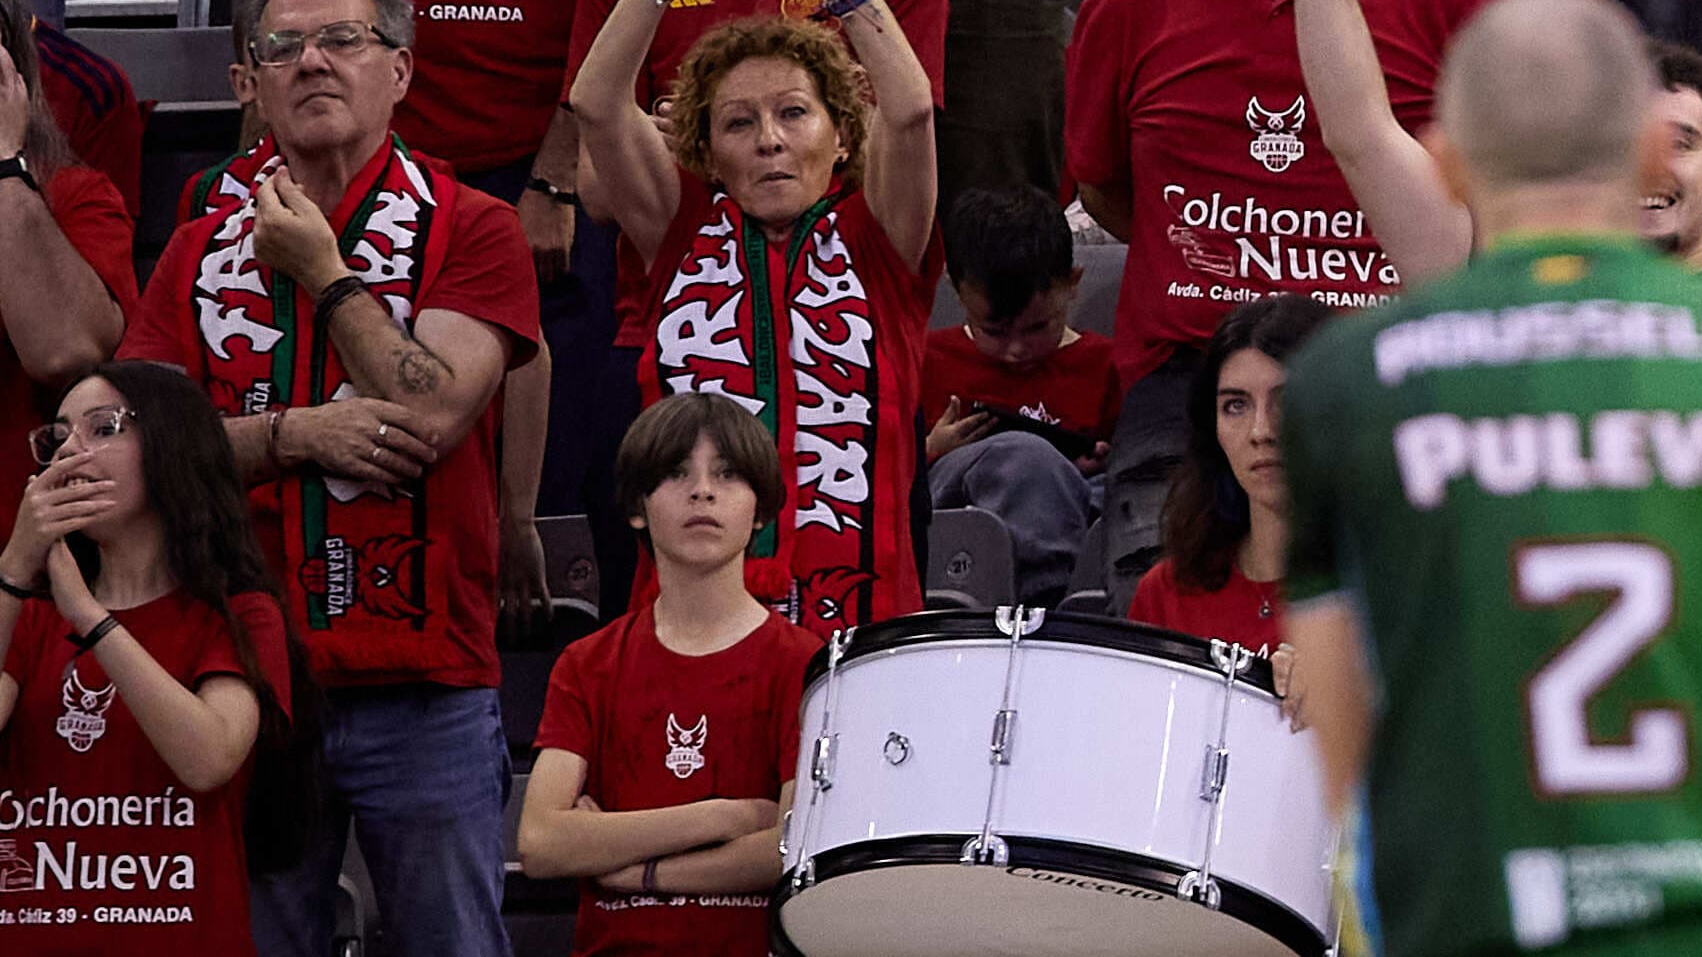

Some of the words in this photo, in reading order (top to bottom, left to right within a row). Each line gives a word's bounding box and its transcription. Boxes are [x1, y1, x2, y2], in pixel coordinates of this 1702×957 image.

[429, 4, 524, 22] GRANADA
[1252, 142, 1303, 154] GRANADA
[1167, 281, 1204, 299] Avda.
[325, 537, 345, 616] GRANADA
[1512, 540, 1690, 801] 2
[34, 840, 196, 891] Nueva
[1005, 865, 1165, 902] Concerto
[55, 908, 77, 924] 39
[93, 906, 193, 924] GRANADA
